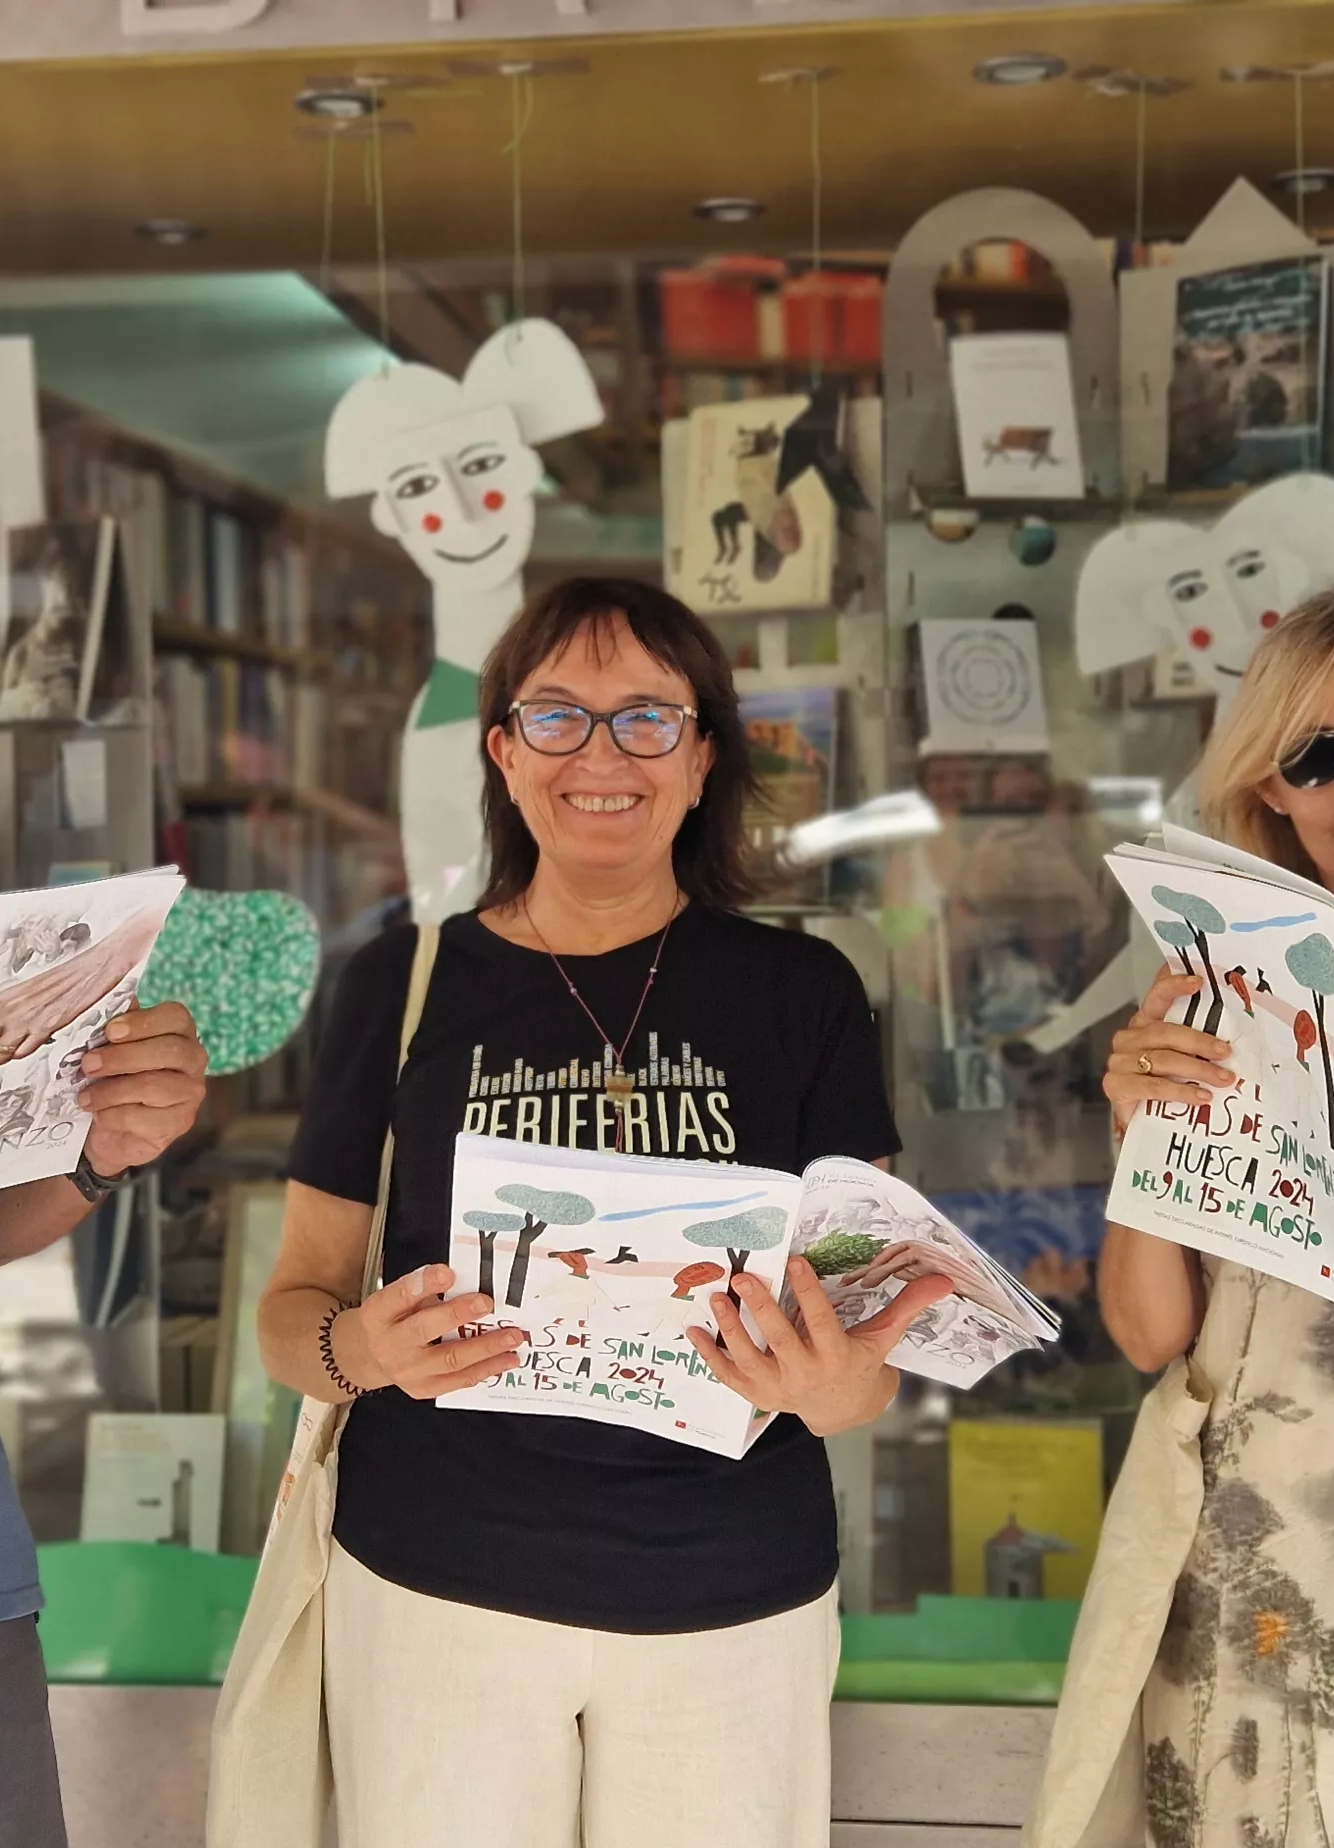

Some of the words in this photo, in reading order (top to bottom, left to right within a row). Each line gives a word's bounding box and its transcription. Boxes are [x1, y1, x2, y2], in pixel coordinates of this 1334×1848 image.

[463, 1091, 736, 1155] PERIFERIAS
[1240, 1113, 1264, 1143] DE
[1266, 1124, 1299, 1168] SAN
[1165, 1132, 1259, 1195] HUESCA
[1268, 1168, 1314, 1217] 2024
[1132, 1169, 1158, 1194] DEL
[1156, 1171, 1174, 1200] 9
[1172, 1179, 1193, 1205] AL
[1198, 1182, 1224, 1214] 15
[1225, 1198, 1246, 1220] DE
[1248, 1201, 1323, 1251] AGOSTO
[565, 1333, 592, 1349] DE
[598, 1337, 645, 1361] SAN
[505, 1372, 527, 1389] AL
[533, 1372, 559, 1391] 15
[562, 1381, 584, 1394] DE
[589, 1382, 676, 1411] AGOSTO
[607, 1362, 665, 1390] 2024
